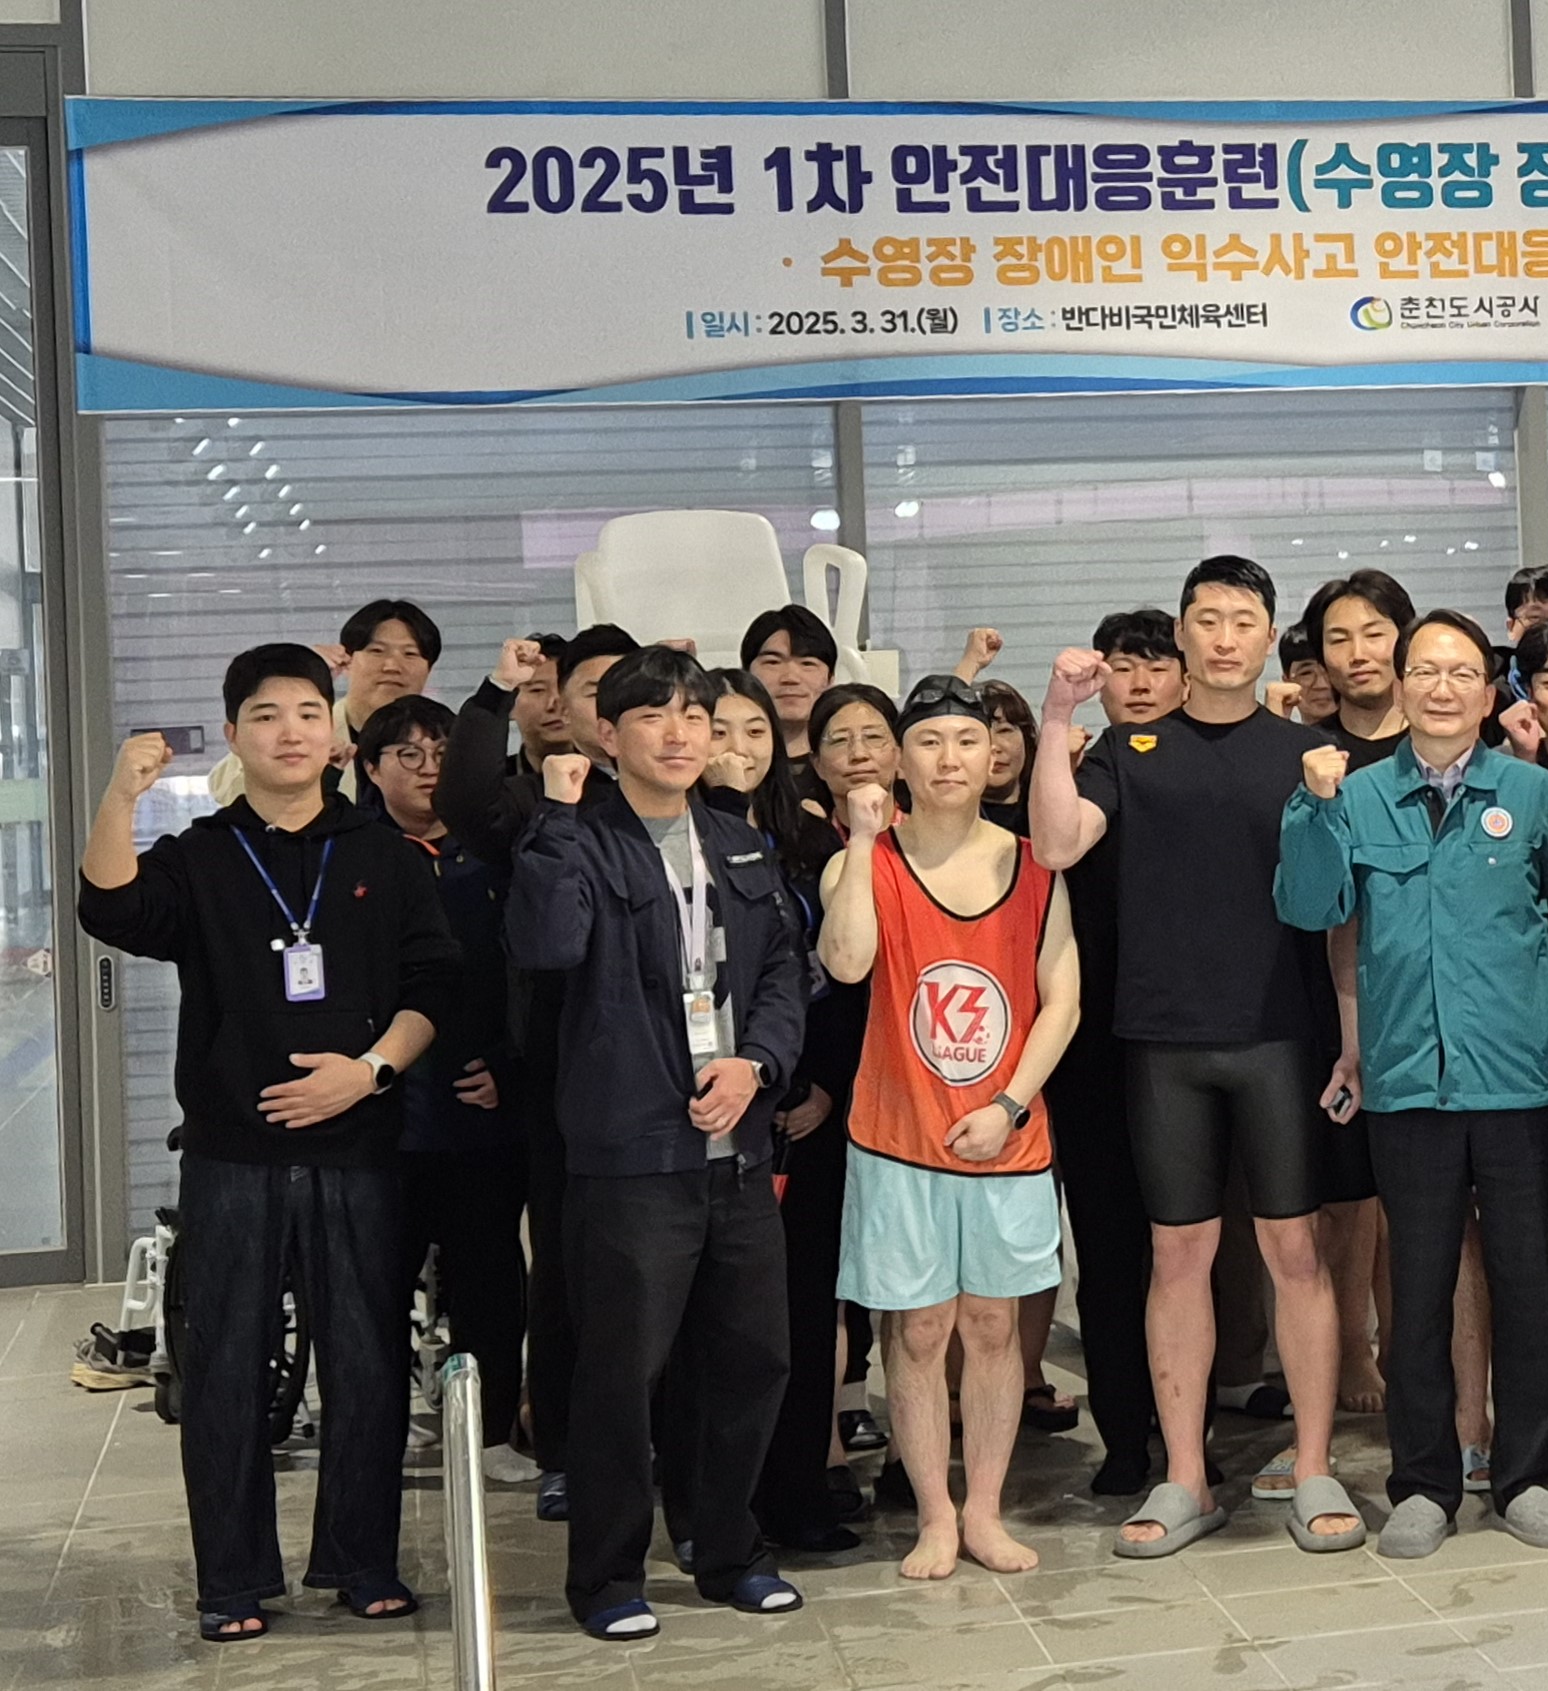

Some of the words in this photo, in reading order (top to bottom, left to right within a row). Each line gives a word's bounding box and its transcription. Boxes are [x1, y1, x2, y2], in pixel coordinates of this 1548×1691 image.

[485, 145, 736, 216] 2025년
[764, 142, 874, 216] 1차
[820, 236, 977, 289] 수영장
[993, 235, 1144, 287] 장애인
[1161, 232, 1360, 284] 익수사고
[1061, 302, 1269, 332] 반다비국민체육센터
[931, 1042, 986, 1063] LAGUE
